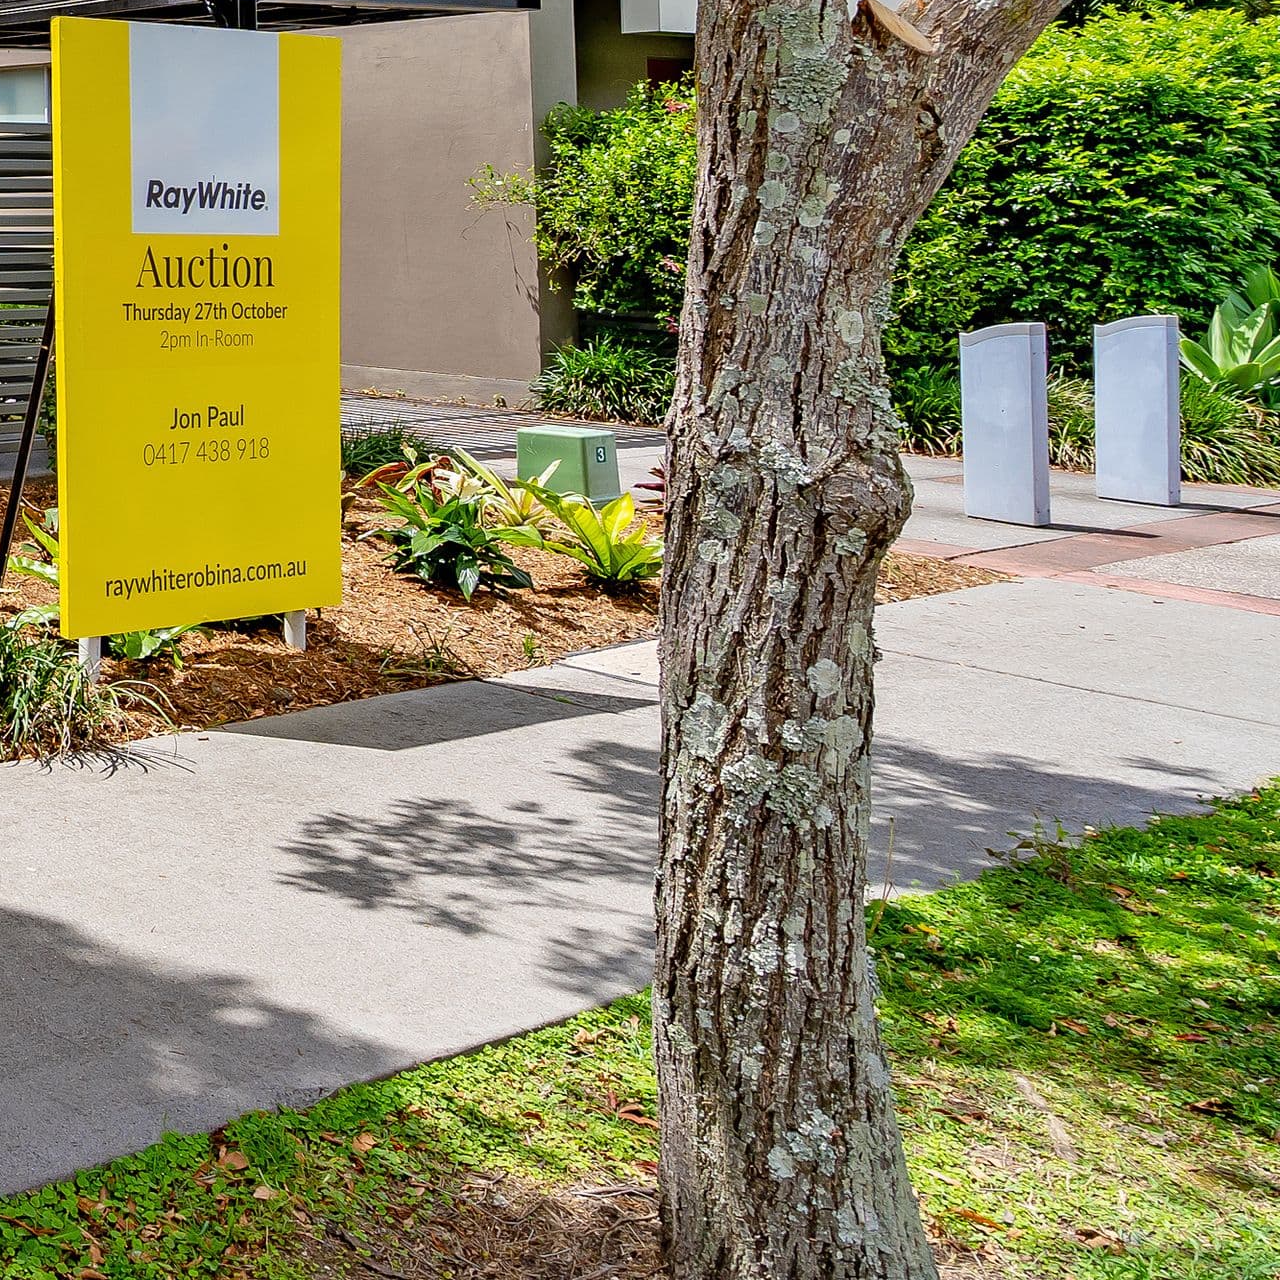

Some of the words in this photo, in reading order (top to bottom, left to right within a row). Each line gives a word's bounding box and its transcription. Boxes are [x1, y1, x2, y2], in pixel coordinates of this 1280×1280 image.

[135, 242, 276, 289] Auction
[122, 302, 191, 324] Thursday
[194, 302, 228, 321] 27th
[231, 301, 289, 320] October
[160, 330, 191, 352] 2pm
[195, 329, 254, 348] In-Room
[169, 407, 202, 430] Jon
[207, 403, 245, 428] Paul
[143, 441, 191, 466] 0417
[195, 439, 231, 463] 438
[236, 437, 270, 460] 918
[597, 447, 605, 462] 3
[105, 559, 307, 600] raywhiterobina.com.au
